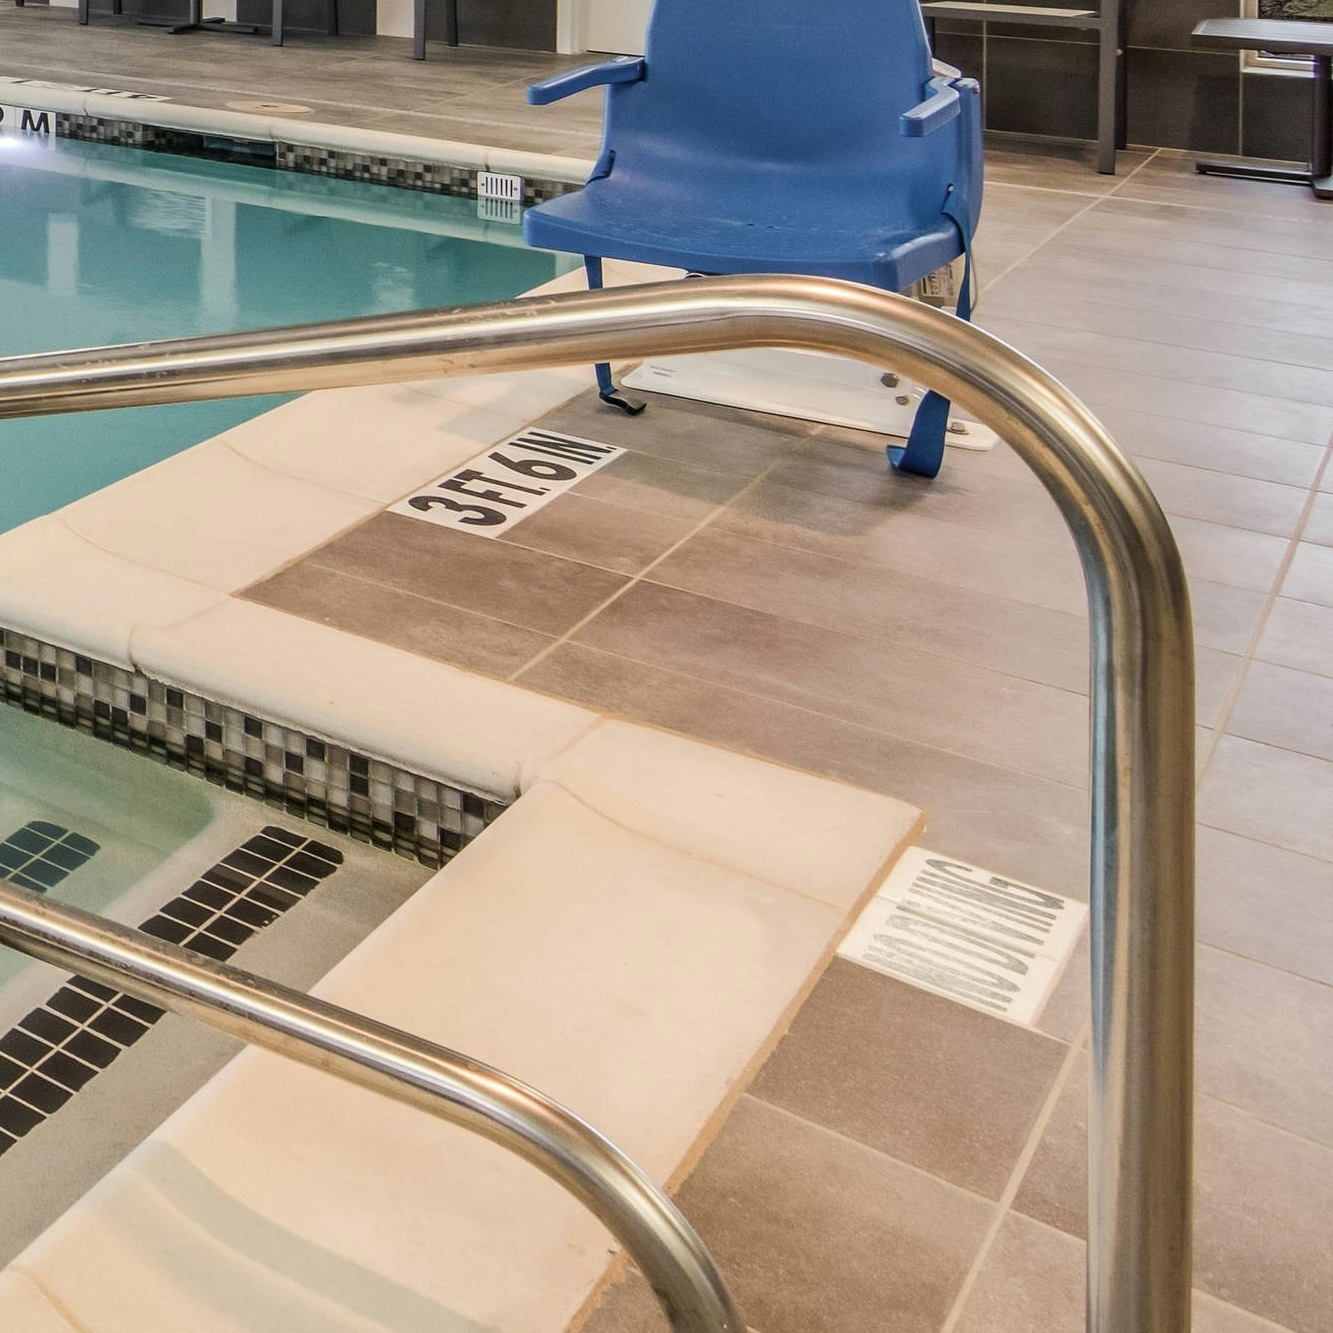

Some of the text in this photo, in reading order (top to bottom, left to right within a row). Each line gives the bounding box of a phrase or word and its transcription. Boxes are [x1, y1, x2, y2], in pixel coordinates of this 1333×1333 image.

[21, 109, 50, 134] M
[408, 431, 617, 526] 3 FT. 6 IN.
[862, 859, 1064, 1012] NO DIVING
